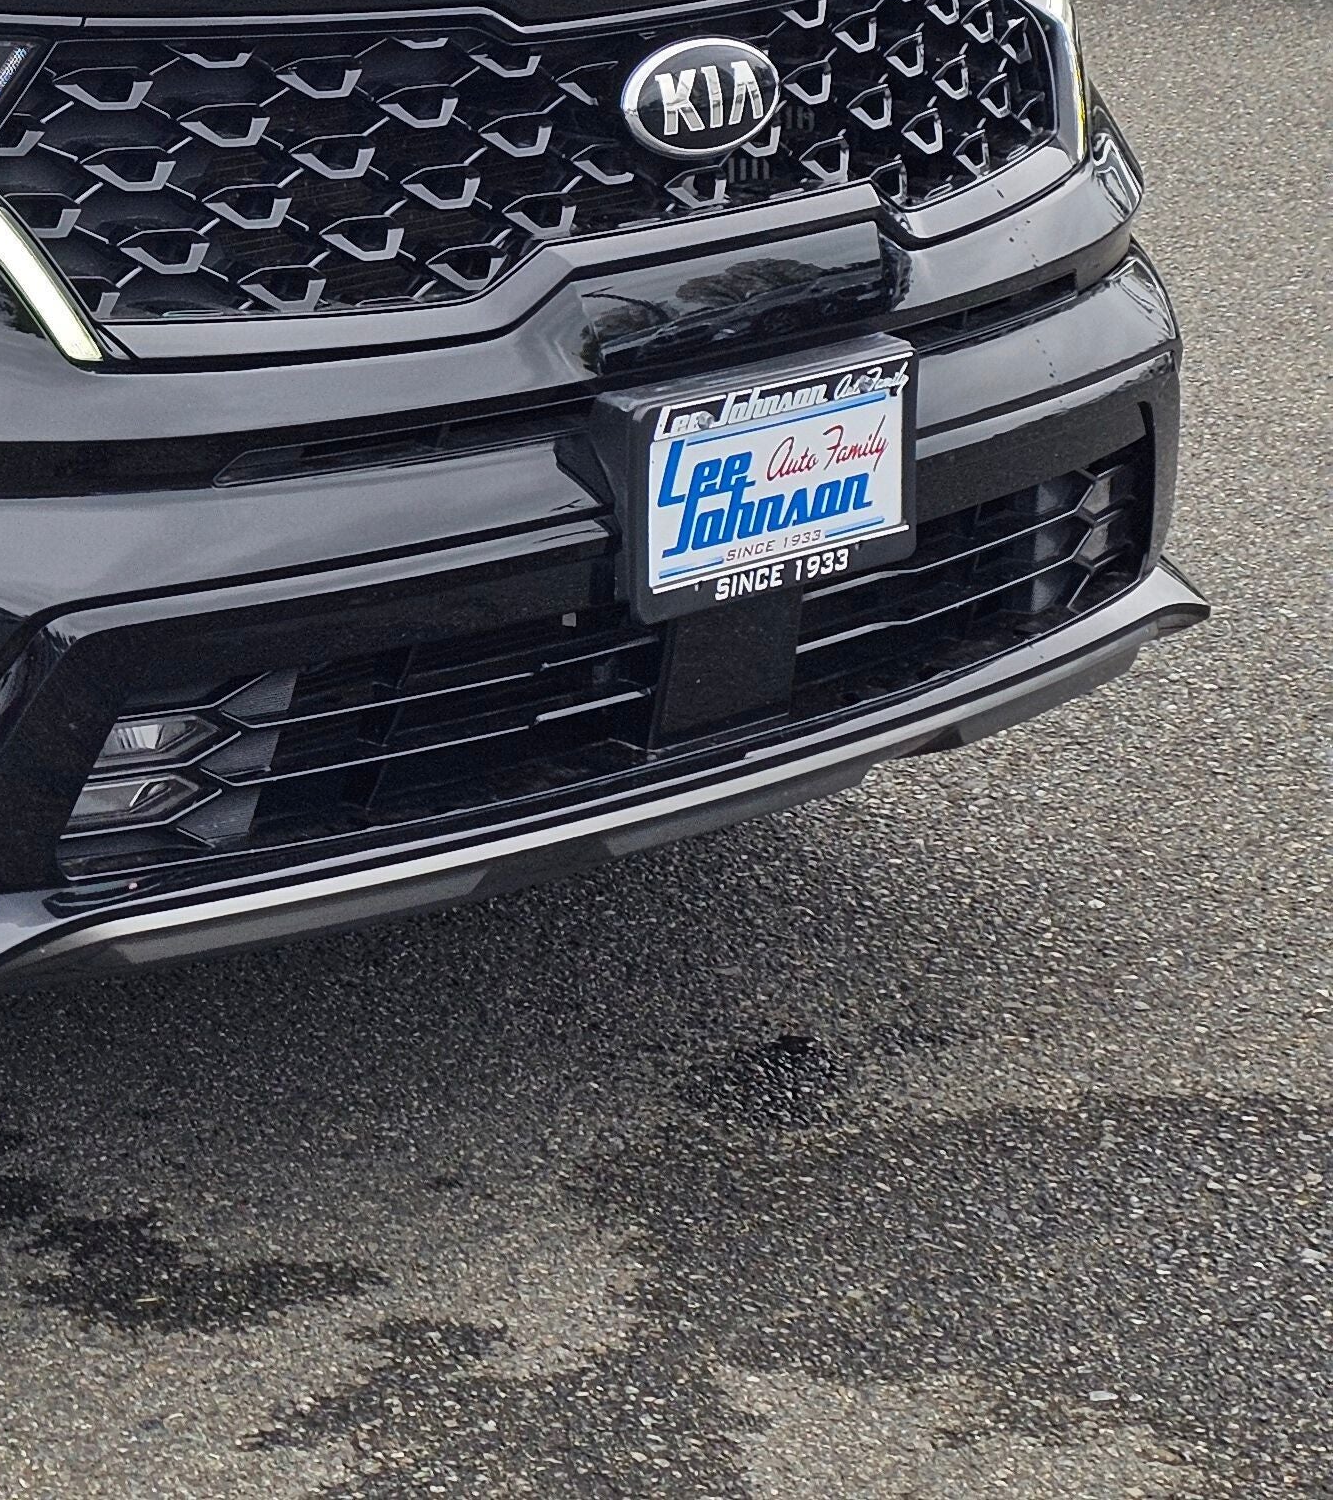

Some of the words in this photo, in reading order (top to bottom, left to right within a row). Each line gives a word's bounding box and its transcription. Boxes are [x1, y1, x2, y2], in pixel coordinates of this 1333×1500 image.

[654, 61, 763, 135] KIA
[710, 382, 829, 429] Johnson
[658, 439, 754, 507] Lee
[766, 436, 819, 481] Auto
[822, 414, 889, 472] Family
[662, 472, 873, 558] Johnson
[726, 540, 773, 562] SINCE
[783, 529, 822, 549] 1933
[715, 563, 784, 601] SINCE
[795, 549, 849, 581] 1933
